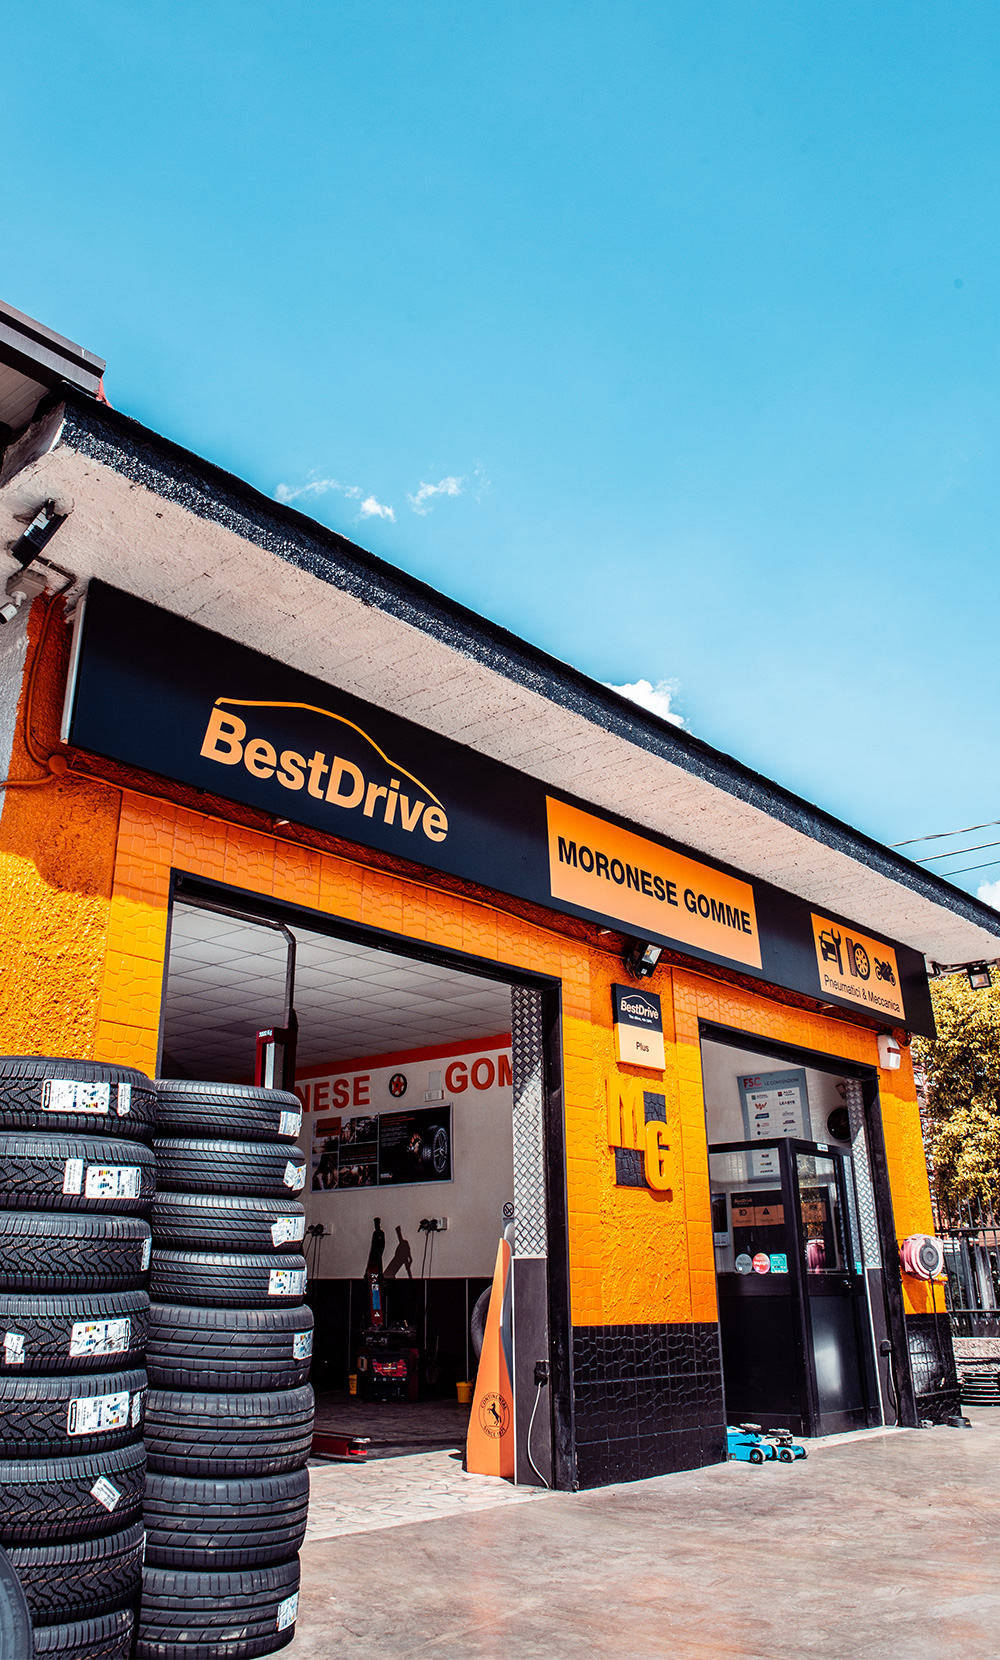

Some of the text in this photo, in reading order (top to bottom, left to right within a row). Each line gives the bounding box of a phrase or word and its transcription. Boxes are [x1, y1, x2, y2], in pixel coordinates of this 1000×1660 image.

[200, 707, 448, 843] BestDrive
[557, 835, 753, 936] MORONESE GOMME
[823, 974, 901, 1013] Pneumatici & Meccanica
[620, 1000, 659, 1020] BestDrive
[635, 1041, 650, 1053] Plus
[743, 1076, 762, 1089] FSC
[480, 1393, 508, 1410] CONTINENTAL
